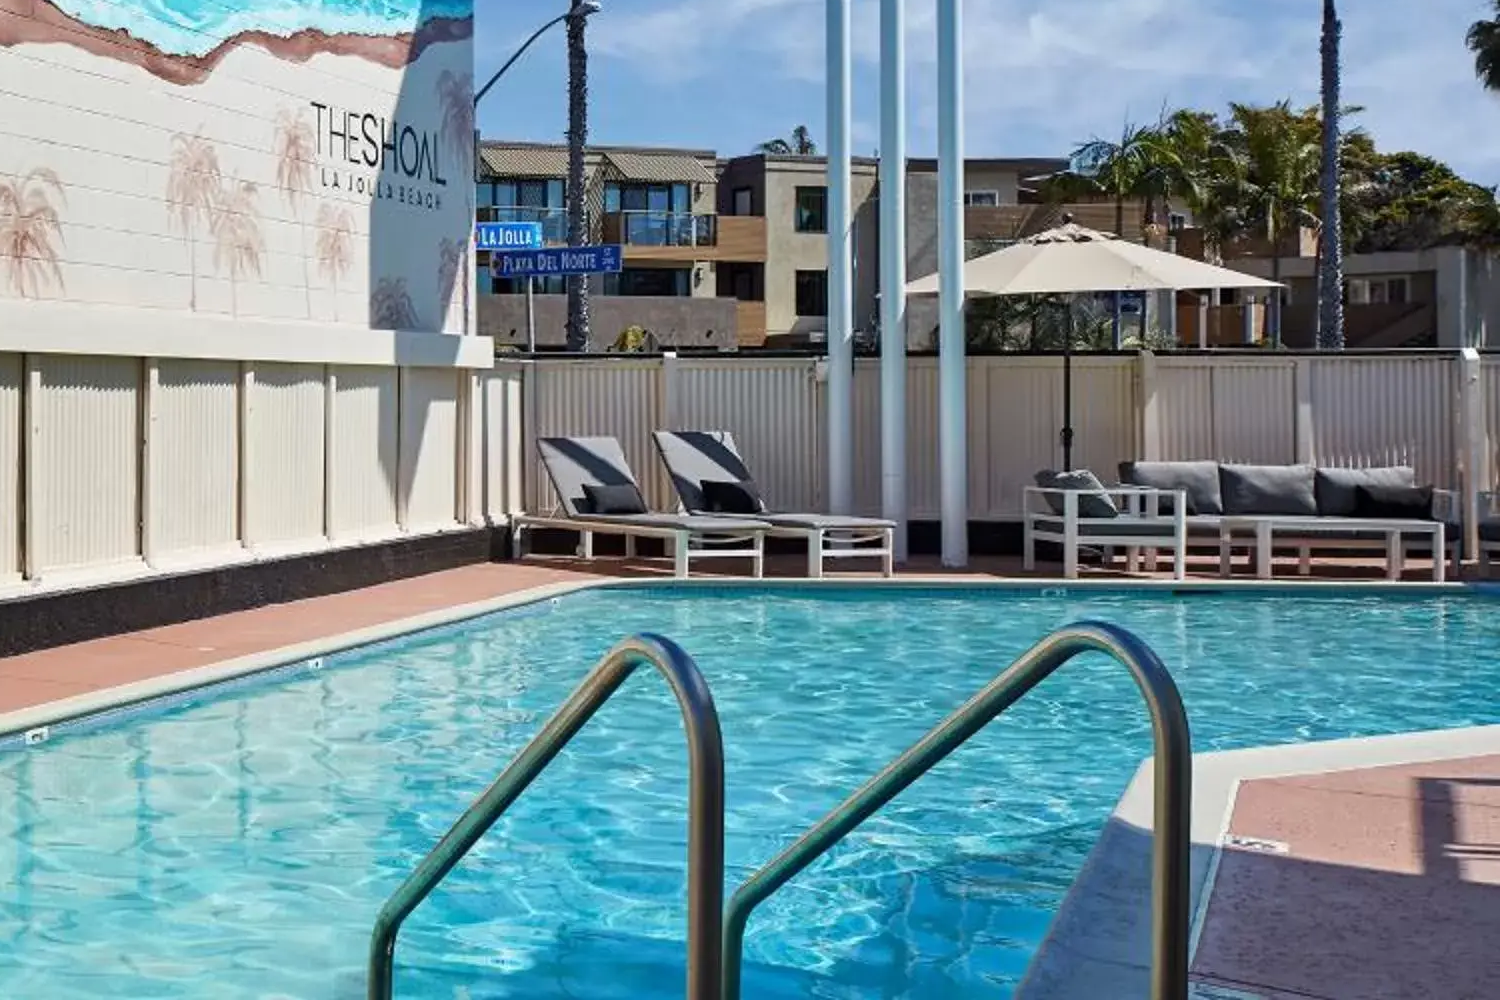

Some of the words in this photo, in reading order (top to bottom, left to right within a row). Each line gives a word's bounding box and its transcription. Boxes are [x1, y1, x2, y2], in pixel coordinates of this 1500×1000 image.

[321, 167, 341, 188] LA
[347, 173, 394, 200] JOLLA
[399, 184, 442, 210] BEACH
[502, 255, 533, 273] PLAYA
[536, 253, 558, 271] DEL
[561, 251, 596, 270] NORTE
